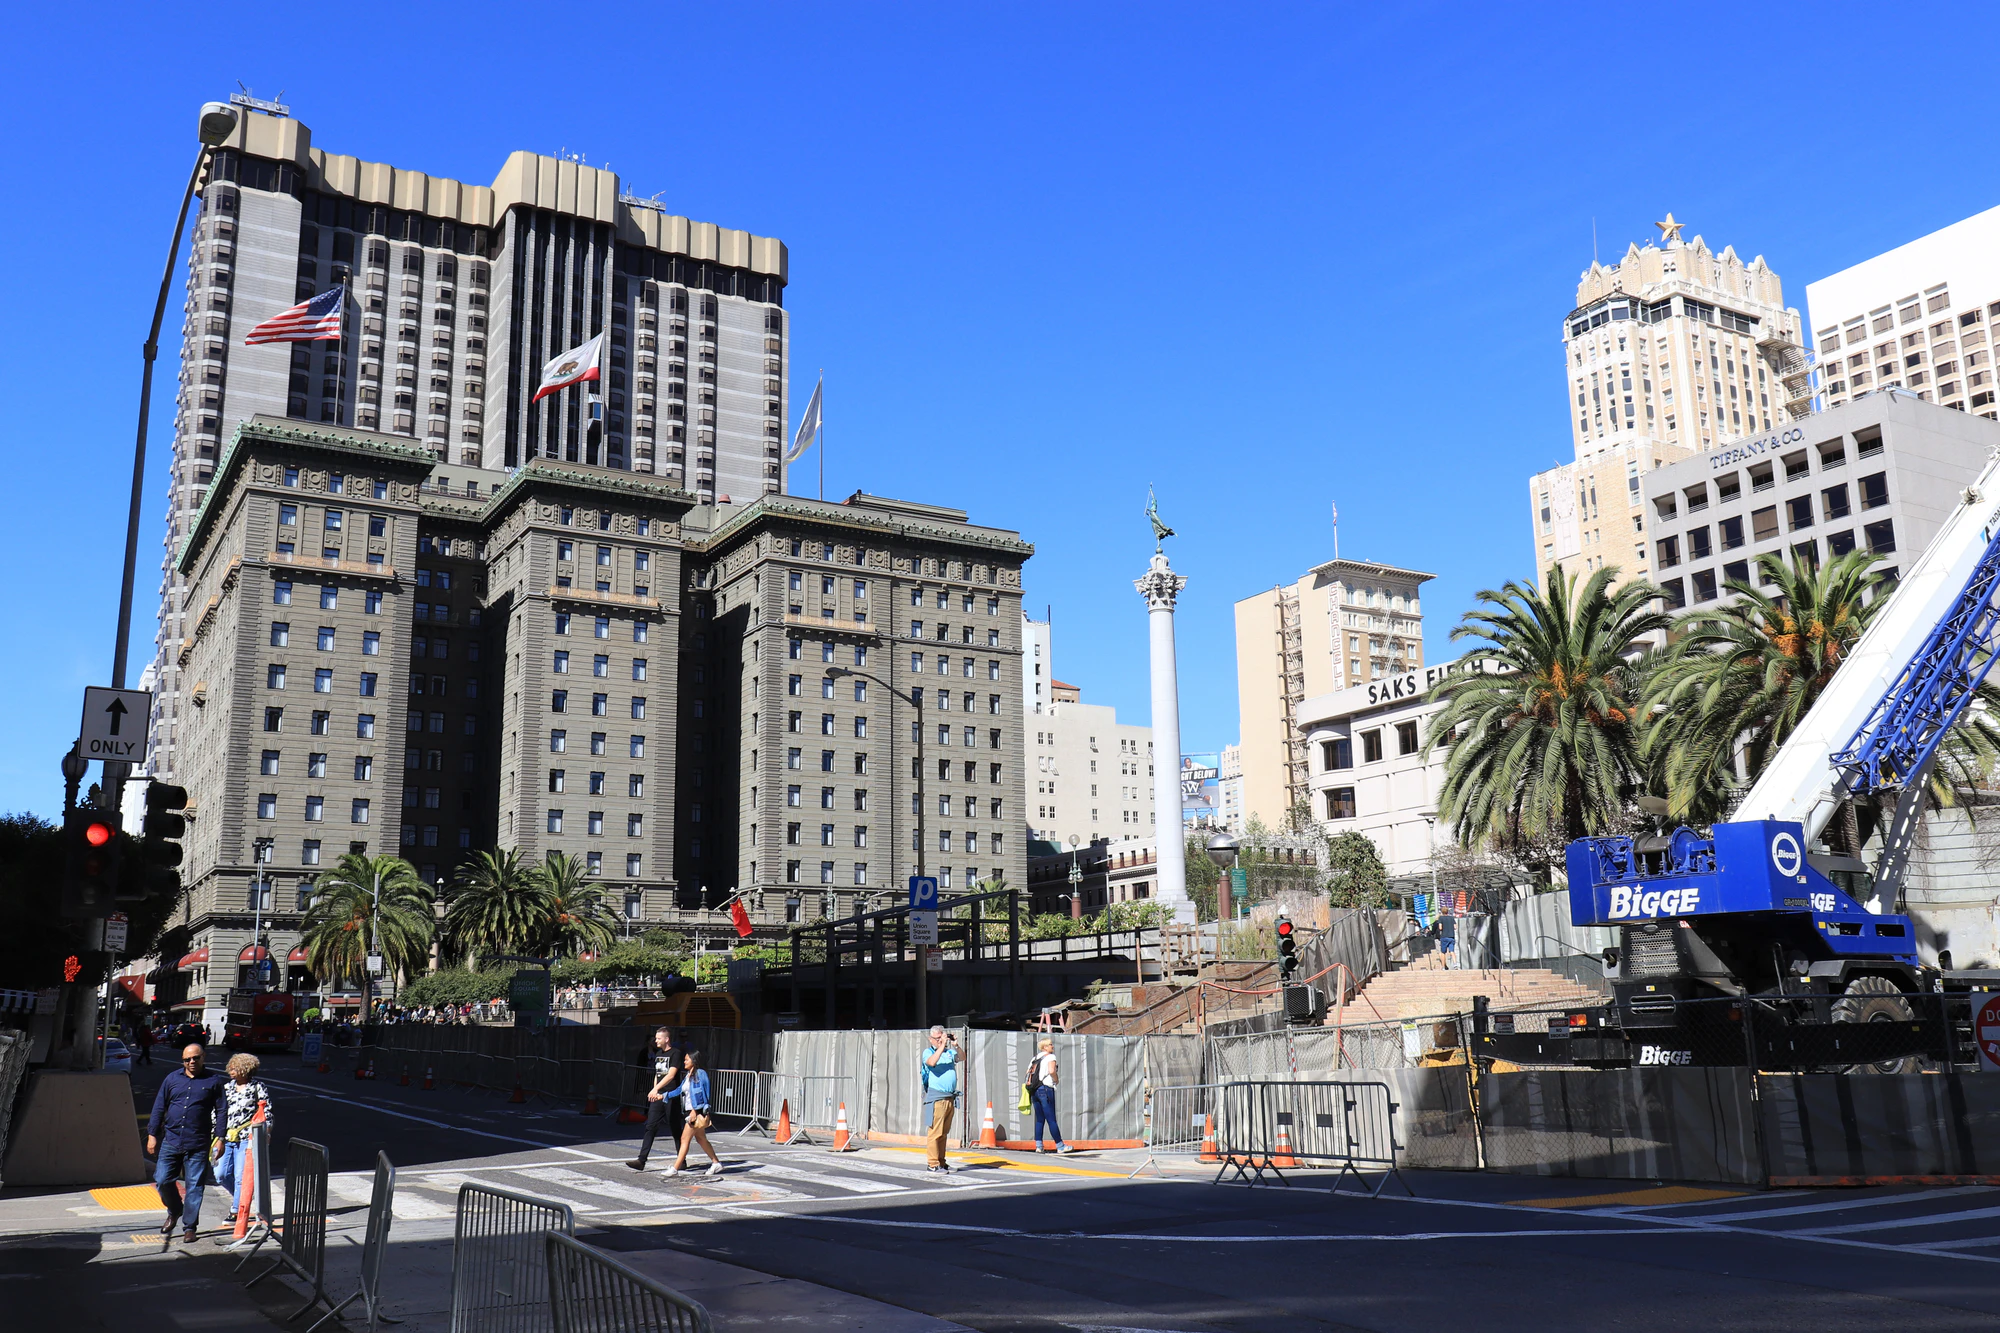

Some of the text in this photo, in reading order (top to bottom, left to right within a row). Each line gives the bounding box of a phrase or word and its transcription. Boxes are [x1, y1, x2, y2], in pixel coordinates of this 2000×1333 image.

[1710, 427, 1805, 469] TIFFANY & CO.
[1368, 675, 1416, 705] SAKS
[90, 739, 136, 755] ONLY
[1193, 769, 1216, 780] BELOW!
